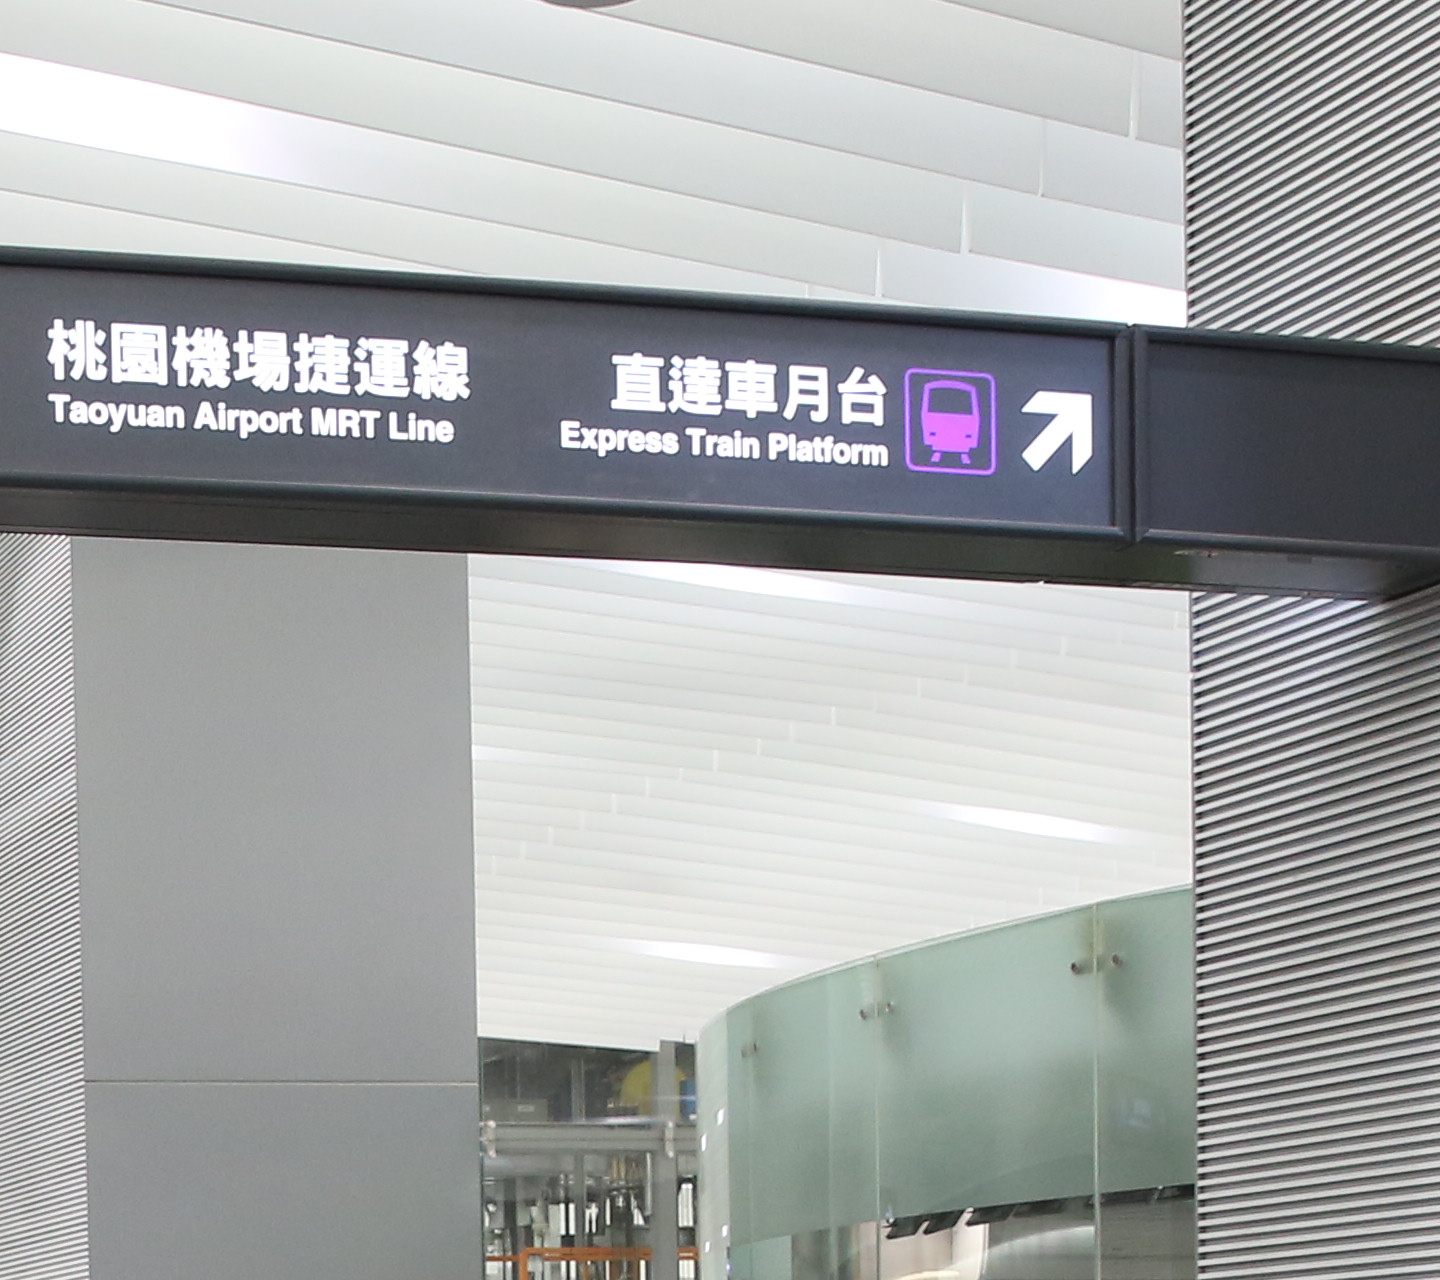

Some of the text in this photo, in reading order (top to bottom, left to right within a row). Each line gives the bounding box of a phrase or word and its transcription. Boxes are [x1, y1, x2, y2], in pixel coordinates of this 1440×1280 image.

[46, 318, 471, 401] 桃園機場捷運線
[610, 352, 887, 428] 直達車月台
[47, 394, 455, 443] Taoyuan Airport MRT Line
[560, 420, 889, 468] Express Train Platform
